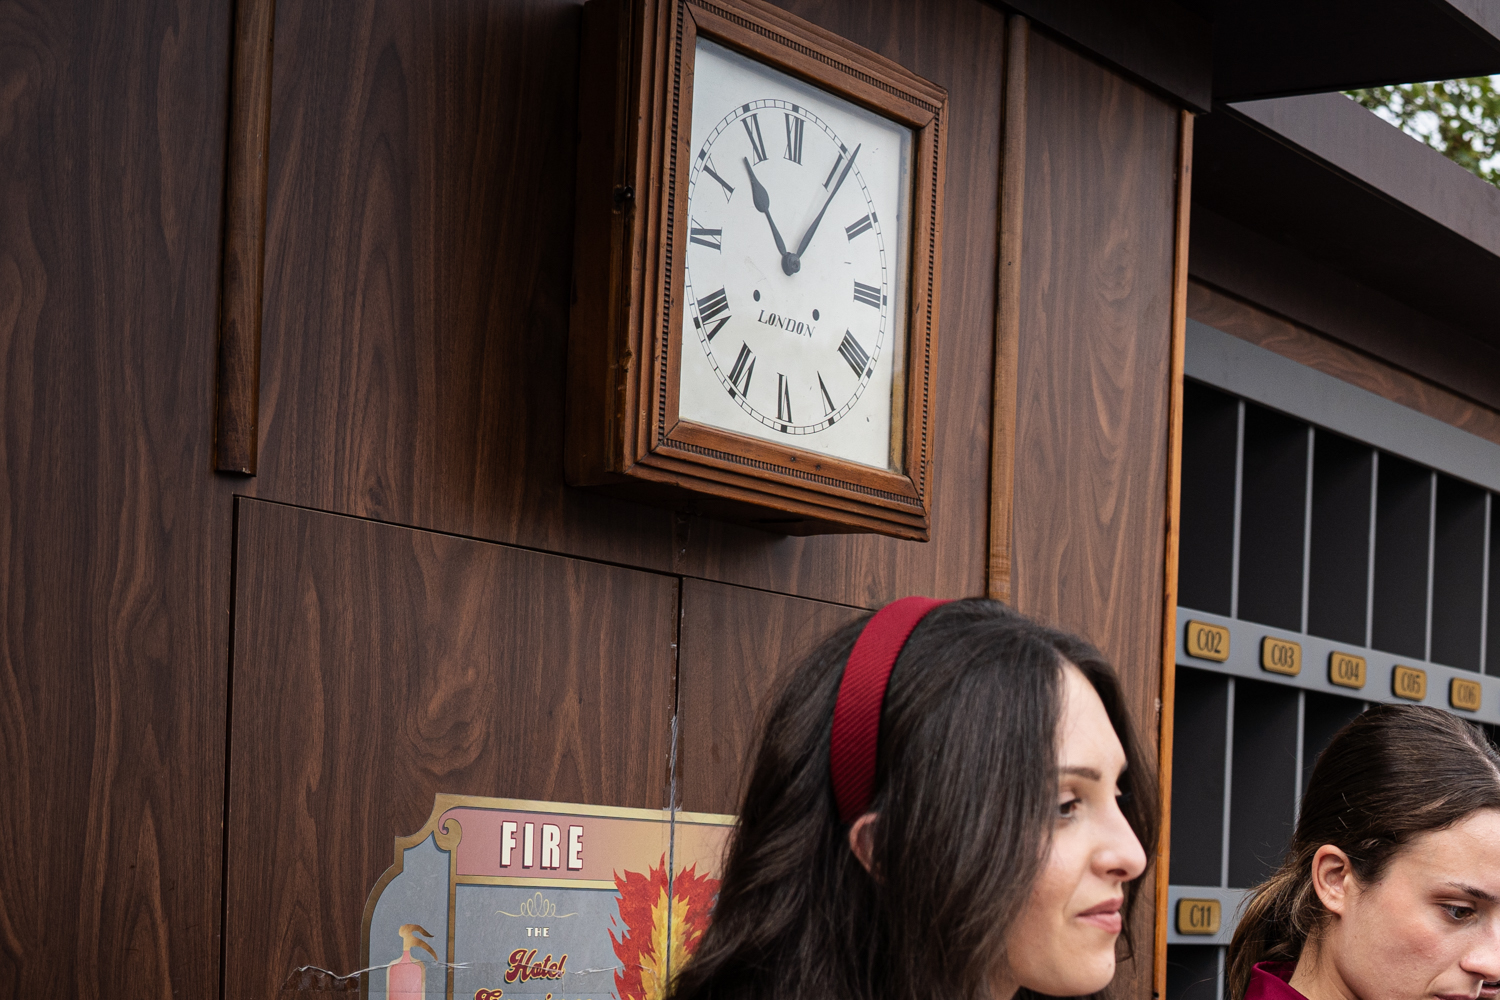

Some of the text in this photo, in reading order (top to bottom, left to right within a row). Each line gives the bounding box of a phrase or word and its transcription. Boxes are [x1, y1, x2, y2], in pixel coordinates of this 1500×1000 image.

[784, 112, 806, 166] XII
[757, 309, 816, 338] LONDON
[1197, 628, 1222, 654] C02
[1271, 644, 1294, 668] C03
[1338, 658, 1359, 682] C04
[500, 820, 585, 871] FIRE
[1190, 904, 1212, 928] C11
[526, 927, 550, 937] THE
[505, 948, 568, 983] Hotel
